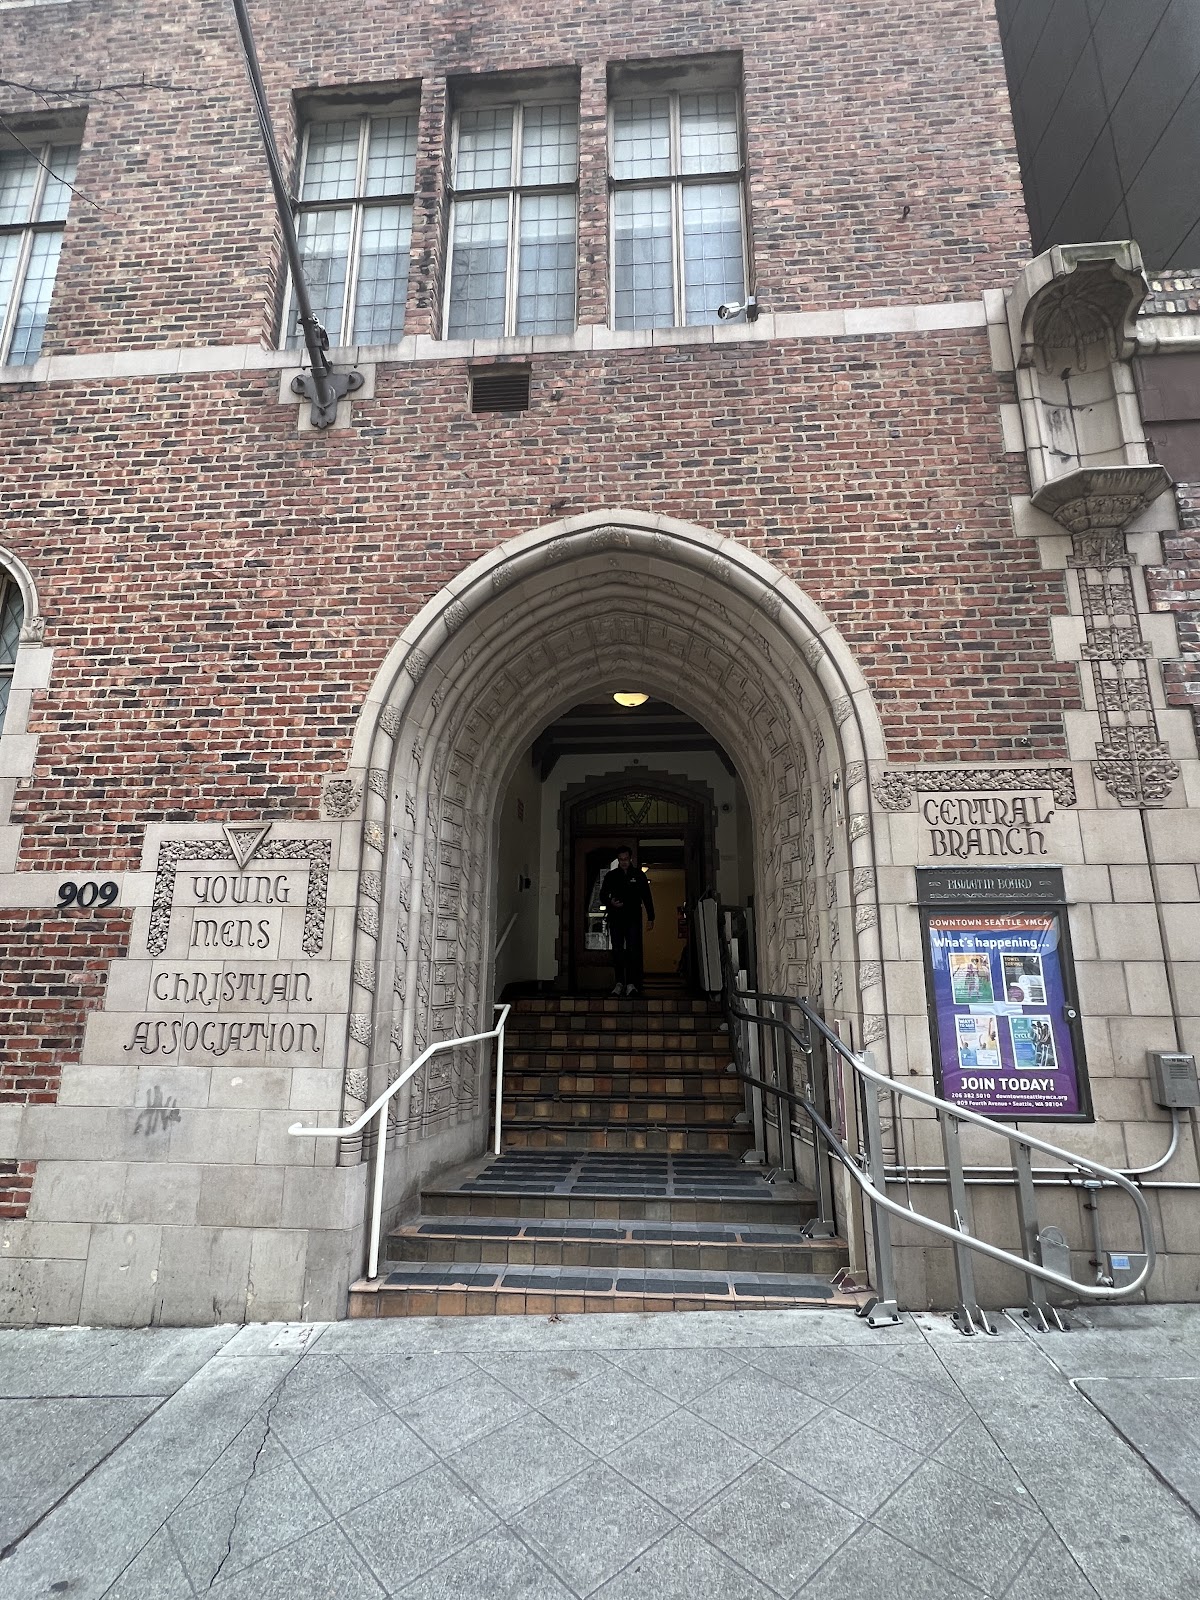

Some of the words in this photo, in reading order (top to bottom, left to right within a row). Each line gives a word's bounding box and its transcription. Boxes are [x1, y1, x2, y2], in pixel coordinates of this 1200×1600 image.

[923, 796, 1055, 827] CENTRAL
[926, 827, 1048, 859] BRANCH
[56, 881, 119, 909] 909
[190, 875, 291, 904] YOUNG
[997, 877, 1032, 889] BOARD
[190, 918, 271, 948] MENS
[929, 918, 982, 926] DOWNTOWN
[984, 918, 1022, 926] SEATTLE
[1024, 918, 1050, 926] YMCA
[933, 936, 974, 948] What's
[152, 971, 313, 1006] CHRISTIAN
[122, 1020, 321, 1056] ASSOCIATION
[960, 1077, 996, 1090] JOIN
[998, 1077, 1055, 1092] TODAY!
